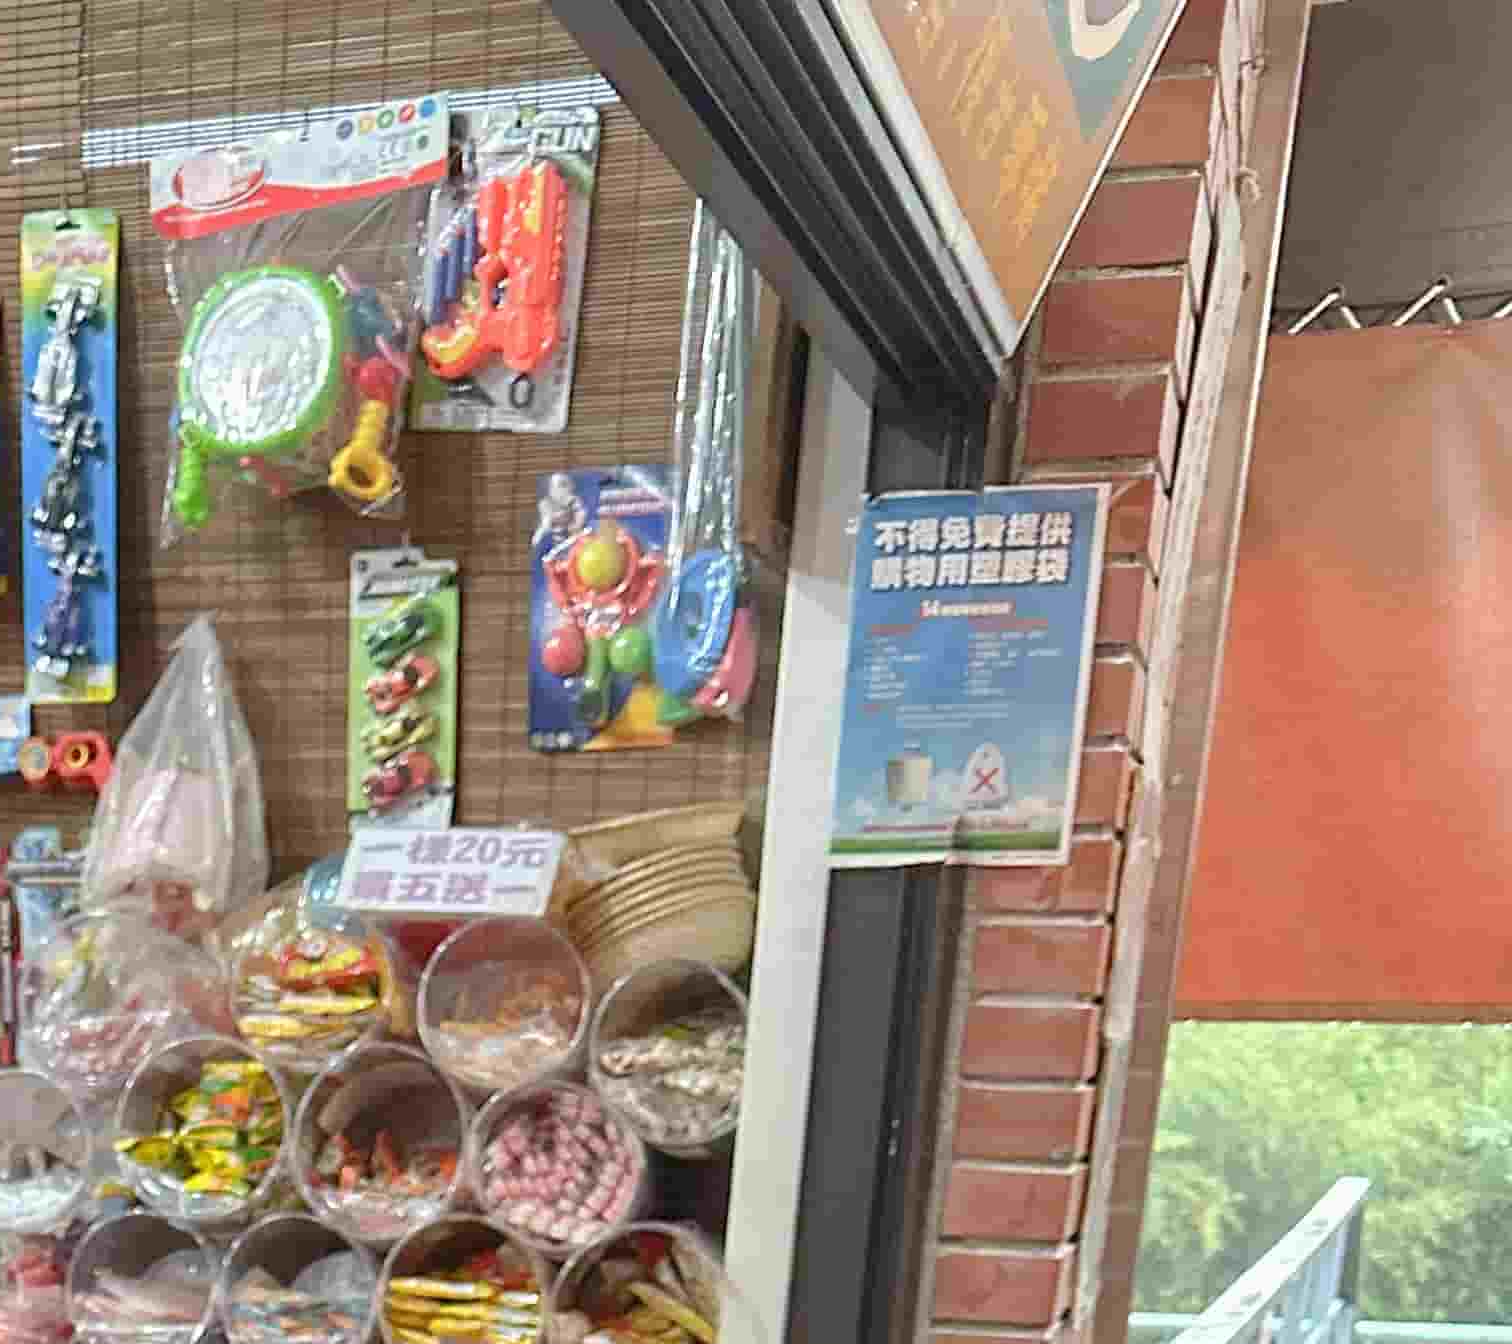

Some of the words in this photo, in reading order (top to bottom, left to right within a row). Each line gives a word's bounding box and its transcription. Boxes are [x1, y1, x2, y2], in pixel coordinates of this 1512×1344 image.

[873, 511, 1073, 552] 不得免費提供
[870, 548, 1070, 591] 購物用塑膠袋
